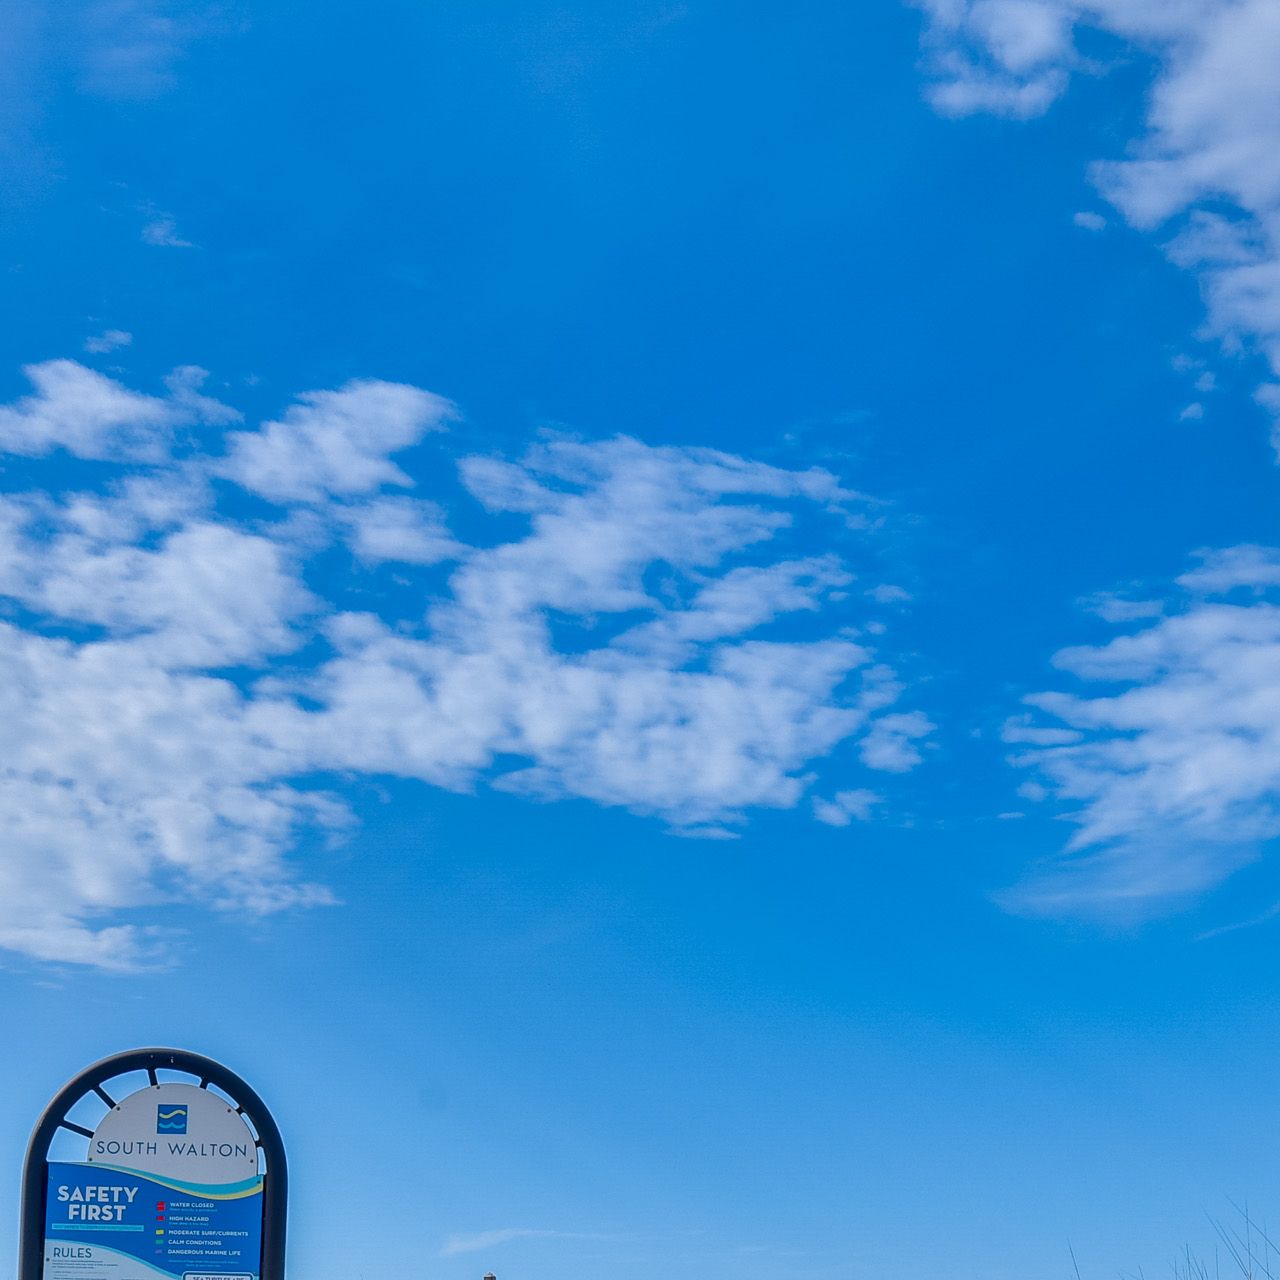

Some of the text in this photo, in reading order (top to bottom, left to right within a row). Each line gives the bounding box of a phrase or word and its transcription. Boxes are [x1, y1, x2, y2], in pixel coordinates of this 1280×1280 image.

[96, 1141, 247, 1157] SOUTH WALTON
[57, 1185, 139, 1203] SAFETY
[68, 1204, 126, 1221] FIRST
[53, 1247, 92, 1258] RULES
